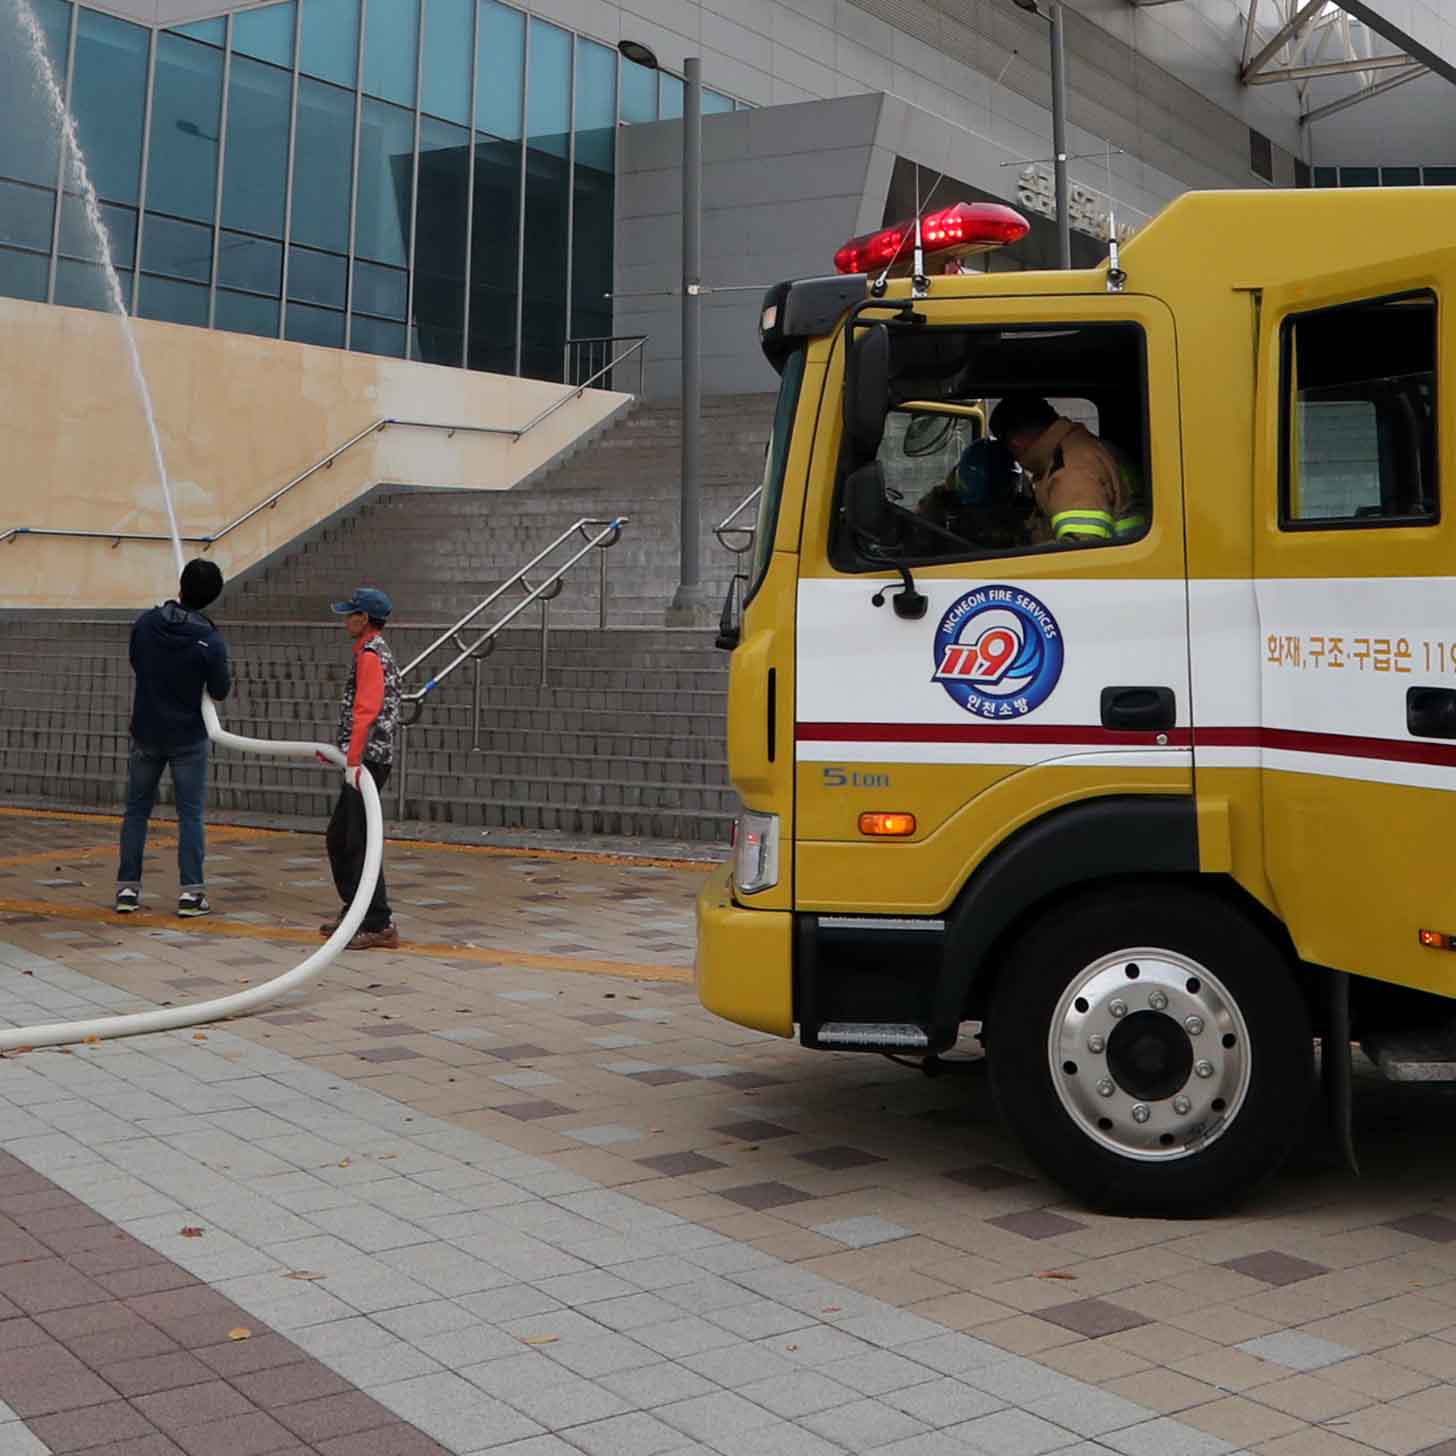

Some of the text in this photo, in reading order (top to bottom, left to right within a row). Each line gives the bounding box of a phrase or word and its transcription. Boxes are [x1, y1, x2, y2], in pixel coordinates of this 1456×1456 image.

[943, 589, 1057, 640] INCHEON FIRE SERVICES
[940, 630, 1016, 677] 119
[967, 694, 1029, 718] 인천소방
